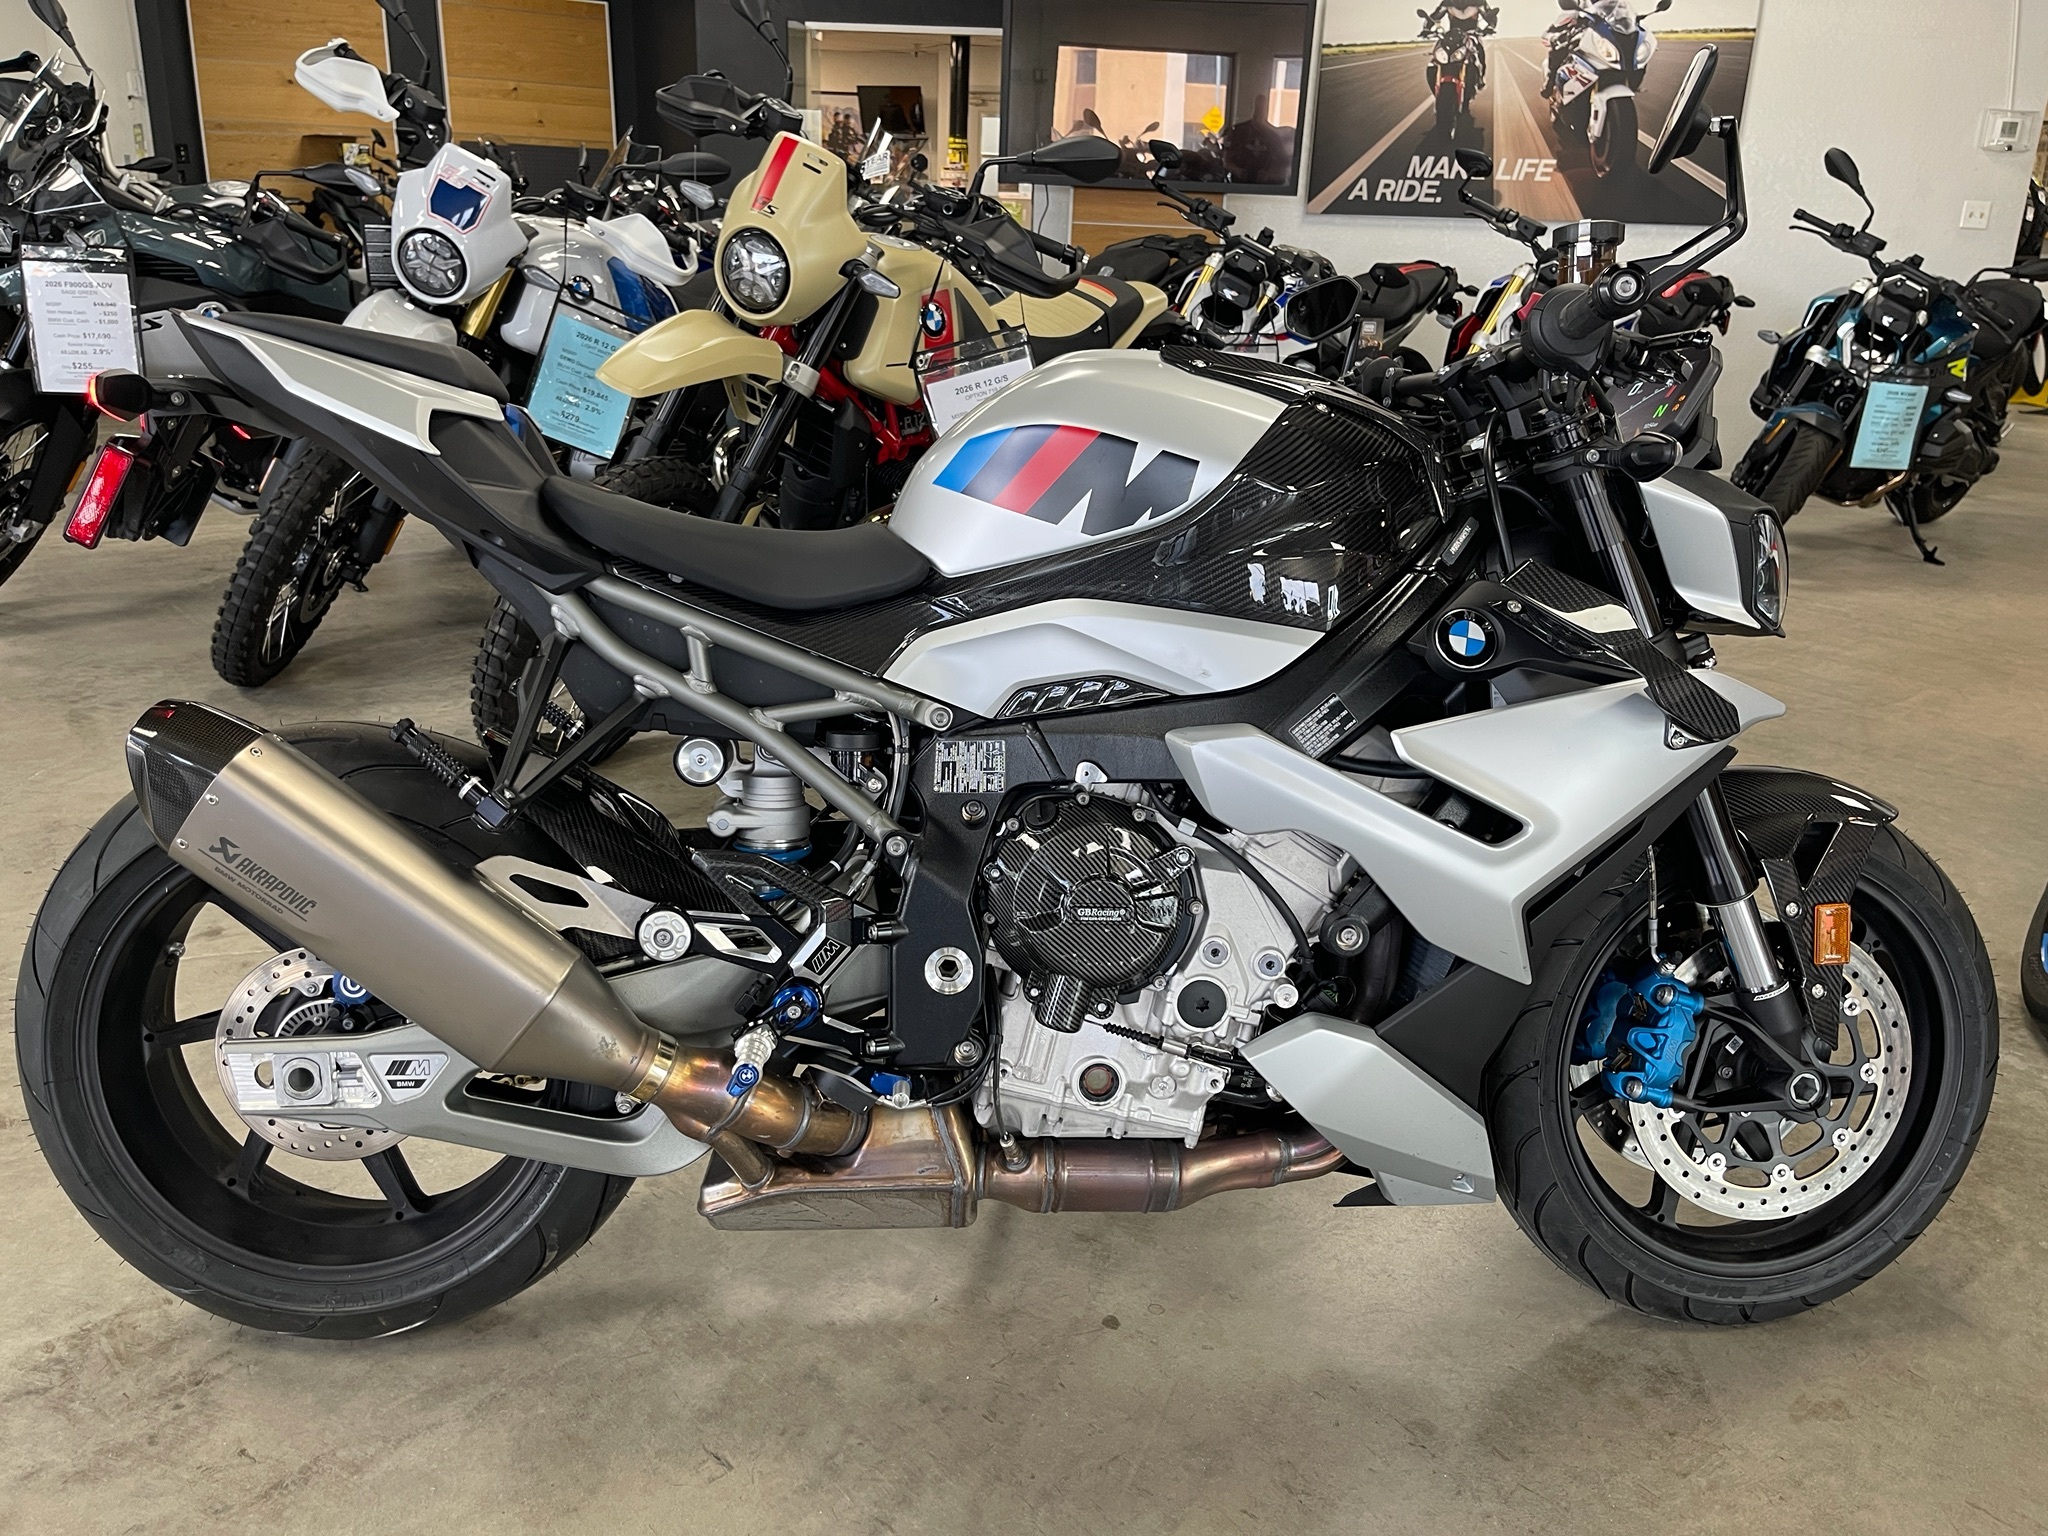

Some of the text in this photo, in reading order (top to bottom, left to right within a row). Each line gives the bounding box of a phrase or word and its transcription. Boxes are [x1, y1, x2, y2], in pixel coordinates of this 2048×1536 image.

[1406, 155, 1558, 182] MAK LIFE
[1348, 178, 1442, 203] A RIDE.
[64, 281, 93, 289] F900GS
[576, 331, 593, 343] 2026
[601, 341, 610, 349] 12
[72, 362, 93, 370] $255
[954, 374, 1009, 396] 2026 R 12 G/S
[965, 390, 988, 401] OPTION
[560, 410, 580, 423] $279
[1652, 403, 1669, 419] N
[1444, 610, 1494, 633] BMW
[214, 866, 236, 882] BMW
[237, 881, 284, 914] MOTORRAD
